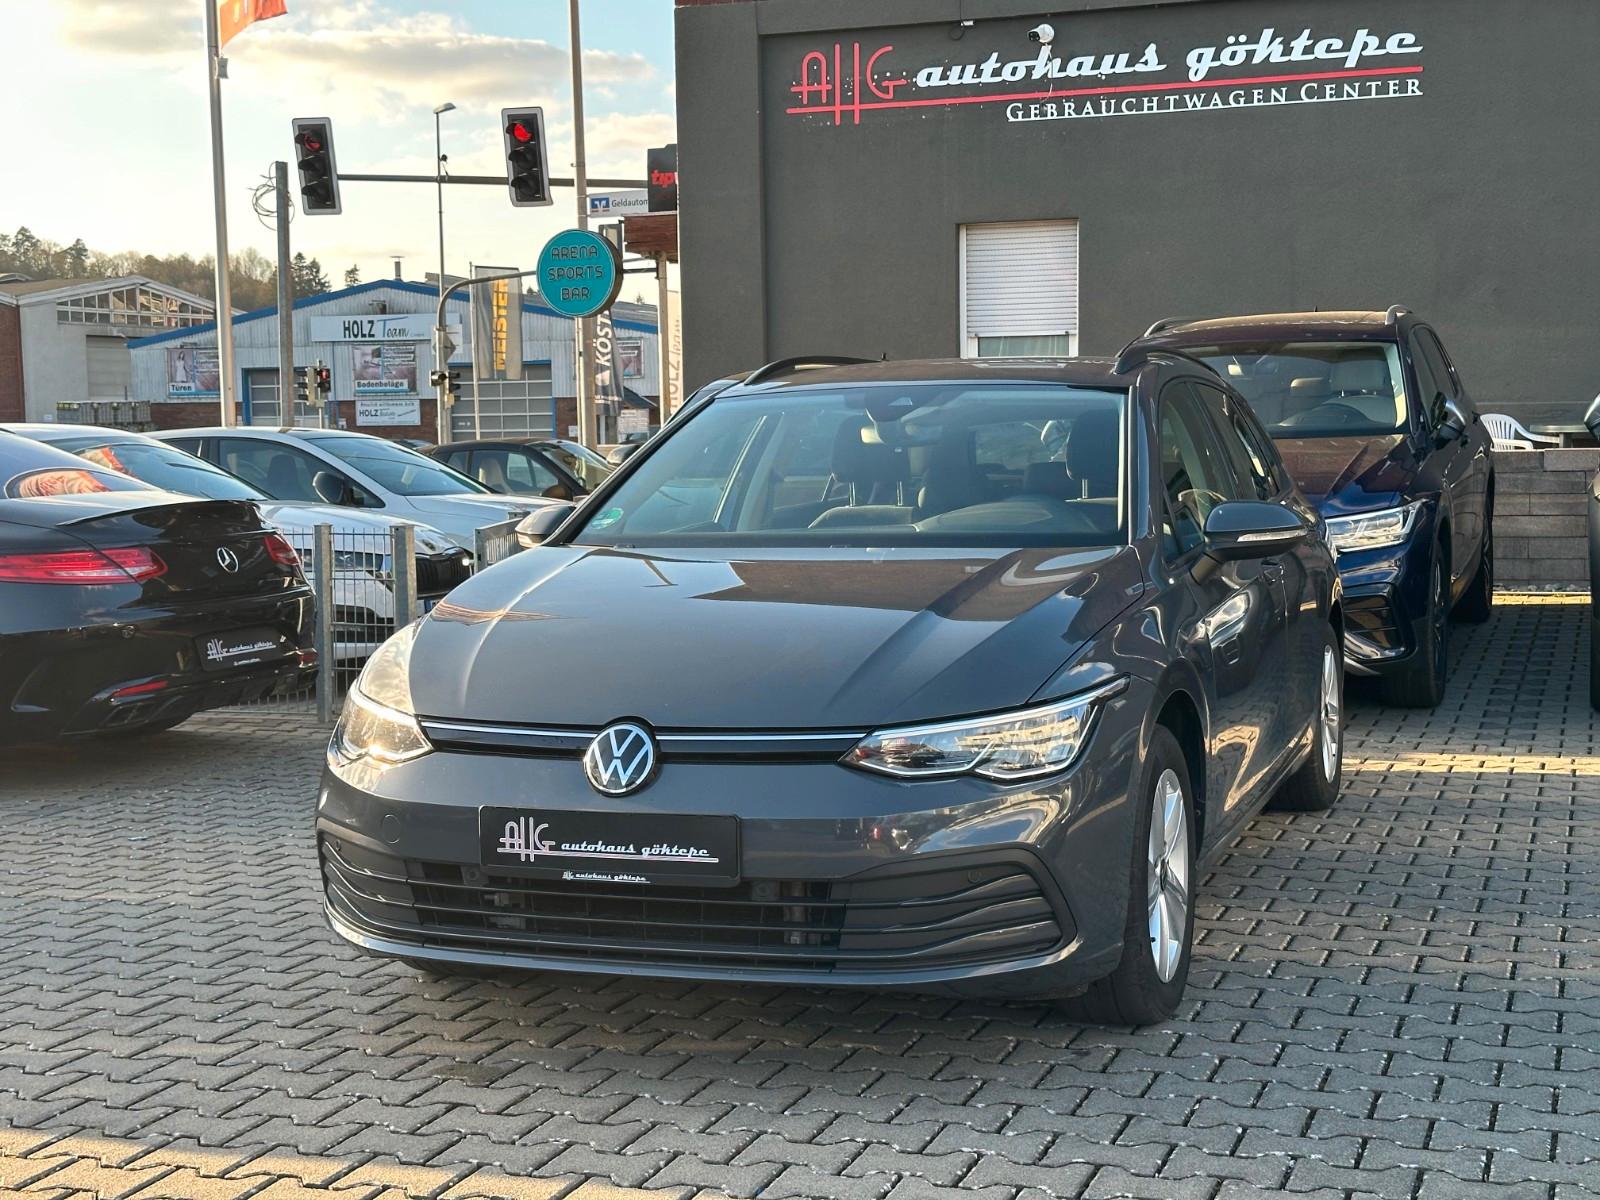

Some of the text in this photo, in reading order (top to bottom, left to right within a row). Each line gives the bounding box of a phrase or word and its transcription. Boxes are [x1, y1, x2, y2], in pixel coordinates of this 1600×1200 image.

[916, 44, 1167, 88] autohaus
[1186, 28, 1424, 82] göktepe
[1006, 78, 1424, 121] GEBRAUCHTWAGEN CENTER
[551, 245, 598, 260] ARENA
[547, 265, 603, 281] SPORTS
[560, 287, 590, 301] BAR
[343, 319, 375, 338] HOLZ
[492, 278, 508, 370] MEISTER
[171, 384, 192, 392] Türen
[359, 409, 379, 417] HOLZ
[561, 840, 636, 854] autohaus
[641, 843, 710, 858] göktepe
